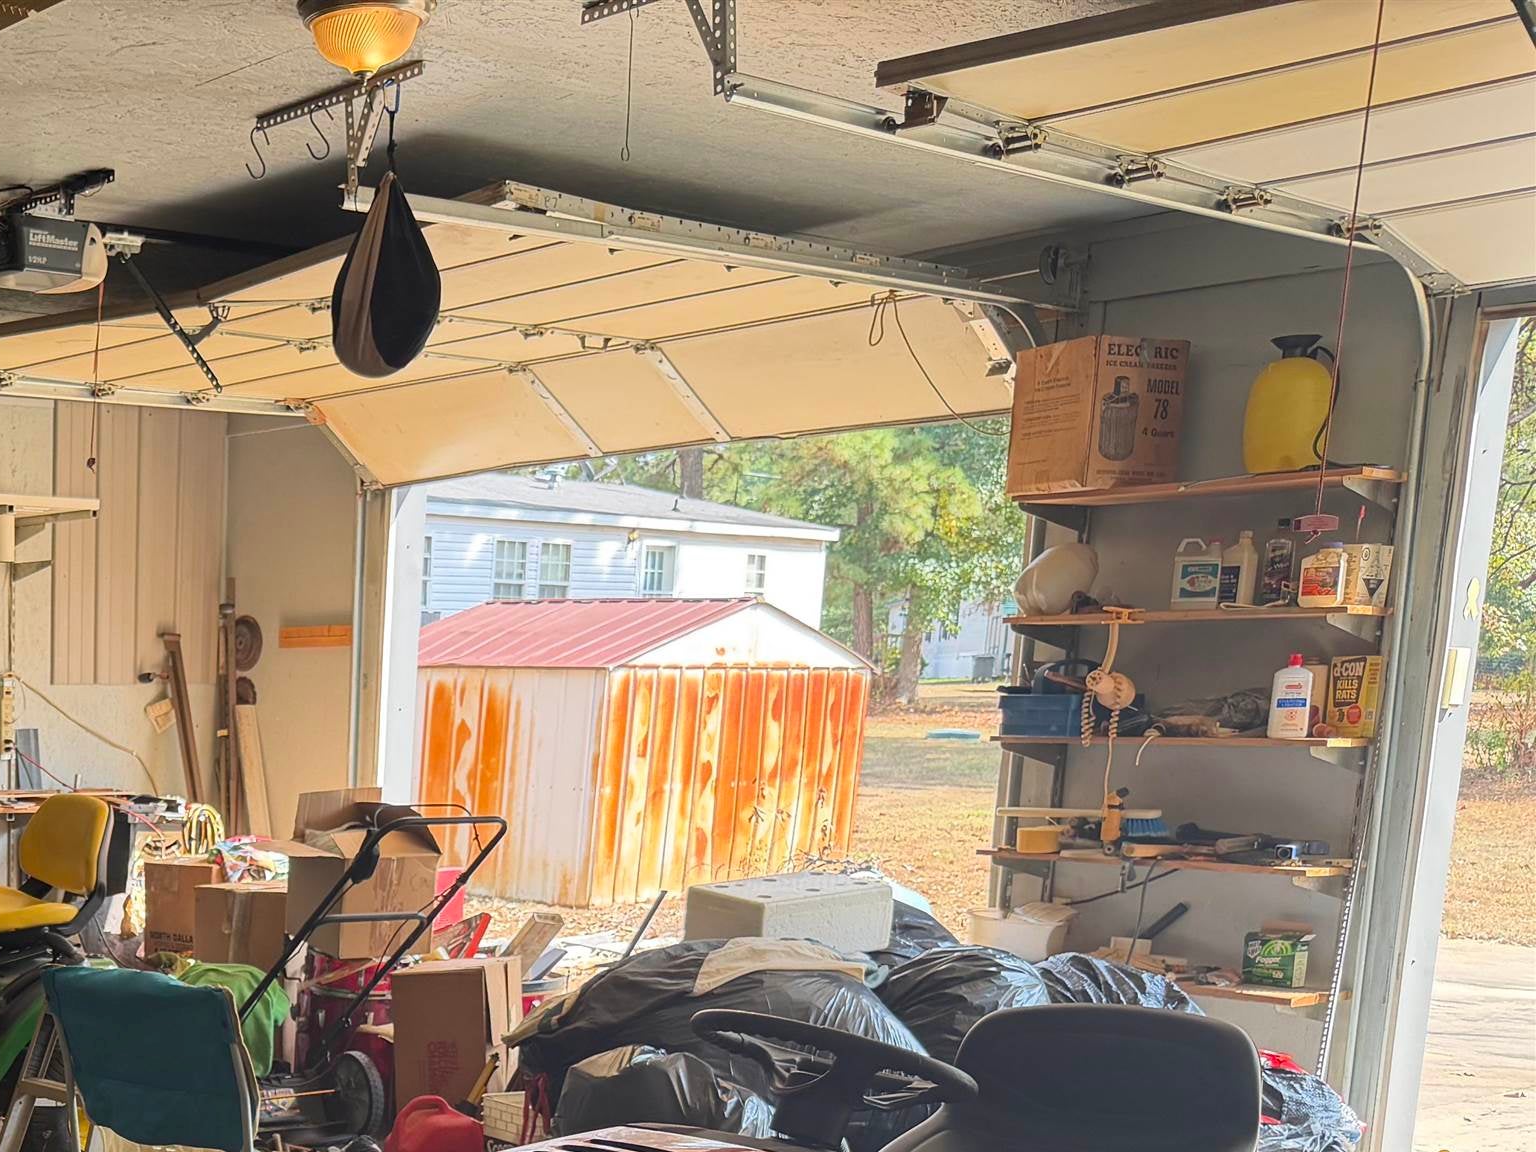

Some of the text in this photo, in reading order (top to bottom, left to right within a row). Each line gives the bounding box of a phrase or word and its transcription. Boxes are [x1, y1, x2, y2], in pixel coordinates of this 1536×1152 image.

[29, 232, 79, 247] LiftMaster
[1107, 342, 1179, 360] ELECRIC
[1146, 378, 1181, 396] MODEL
[1153, 398, 1169, 421] 78
[1336, 679, 1359, 690] KILLS
[1335, 689, 1358, 700] RATS
